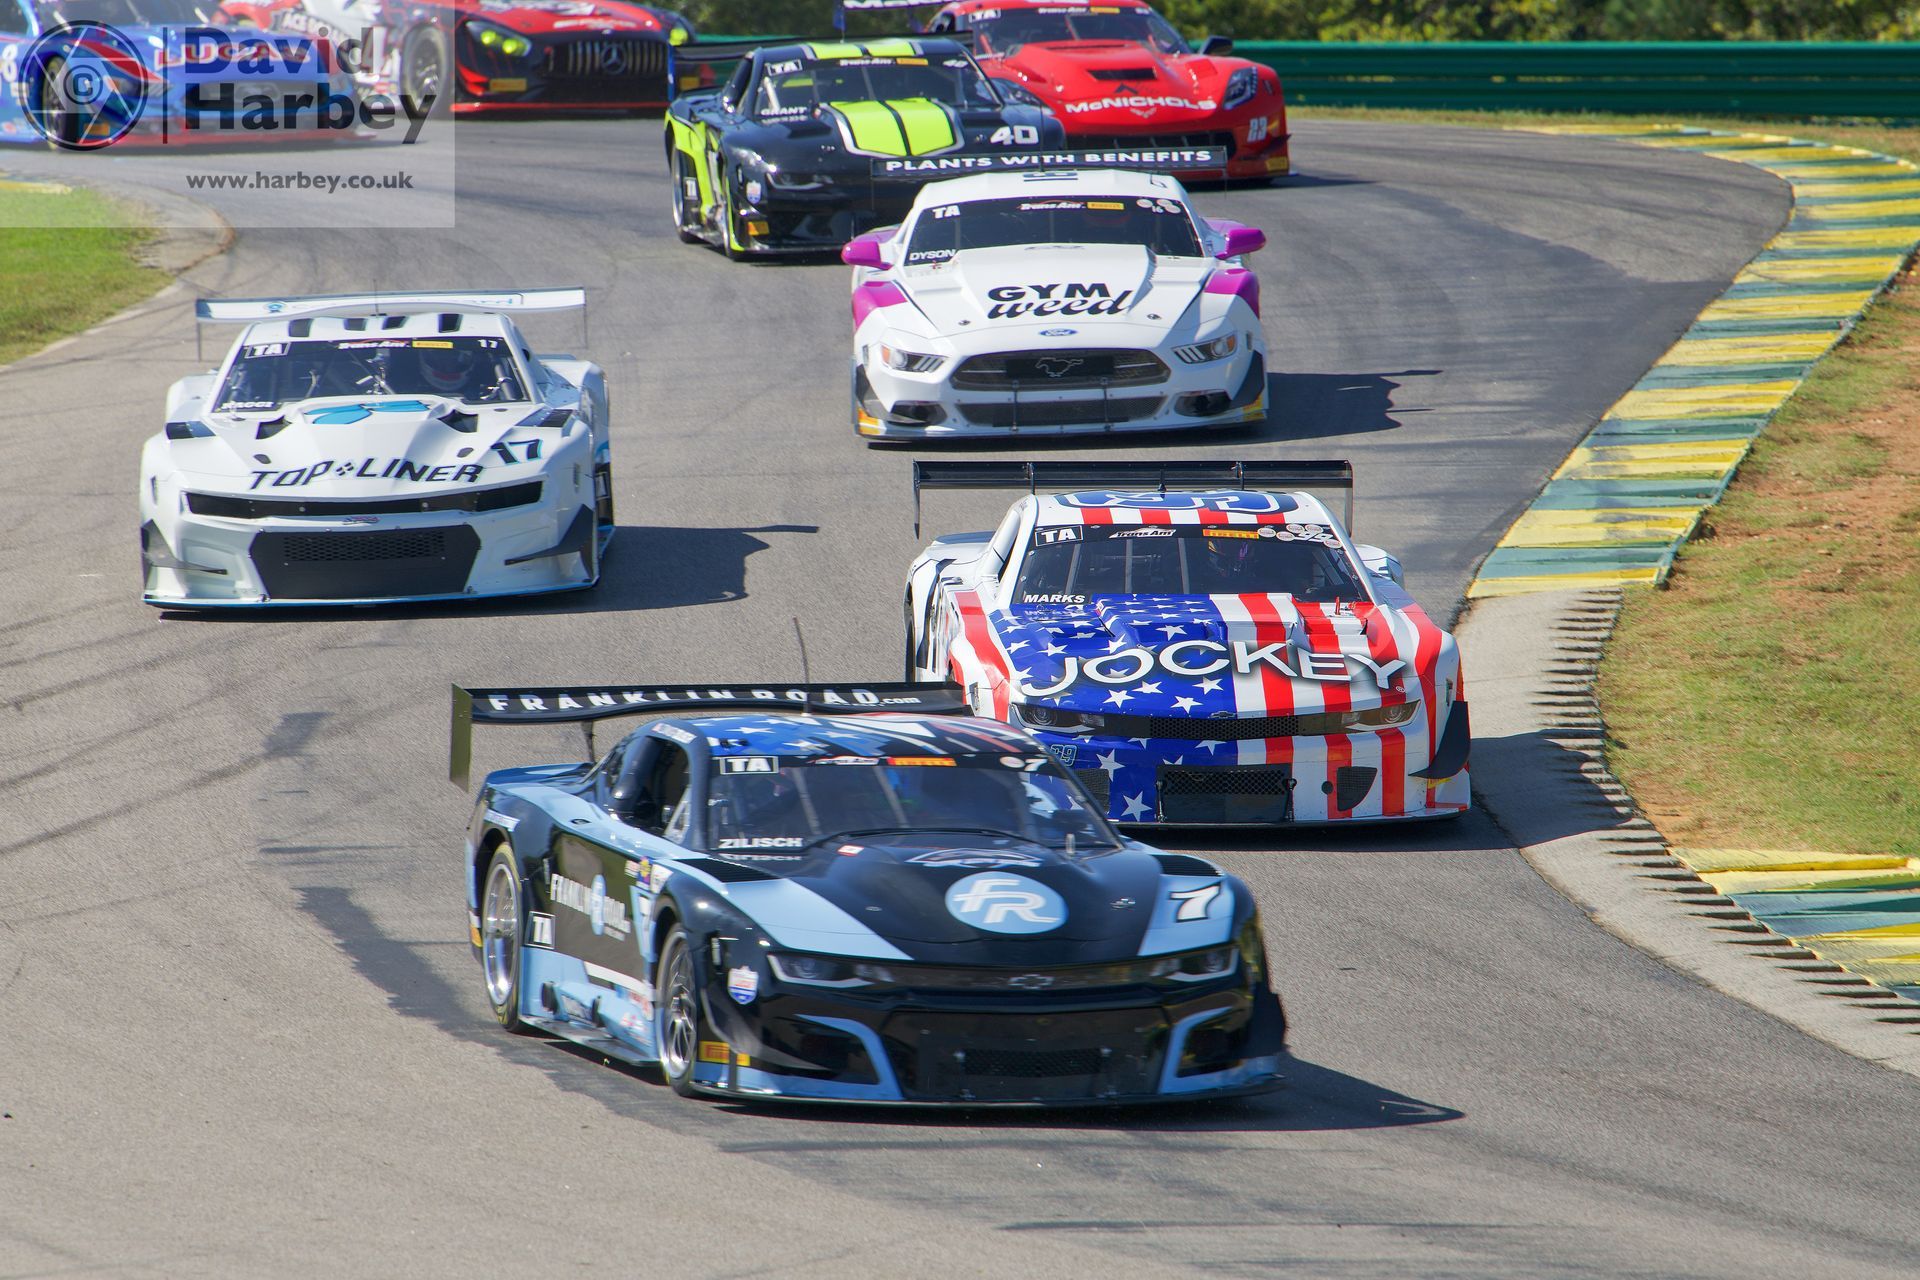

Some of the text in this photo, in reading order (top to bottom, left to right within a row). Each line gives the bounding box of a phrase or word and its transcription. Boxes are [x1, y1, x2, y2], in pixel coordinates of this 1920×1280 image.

[975, 9, 997, 21] TA
[155, 43, 310, 69] LUCAS
[774, 62, 798, 74] TA
[760, 106, 808, 117] GRANT
[1065, 95, 1217, 114] McNICHOLS
[990, 125, 1039, 145] 40
[886, 150, 1212, 172] PLANTS WITH BENEFITS
[933, 205, 960, 219] TA
[909, 249, 956, 261] DYSON
[988, 283, 1112, 301] GYM
[988, 290, 1133, 319] weed
[254, 343, 283, 356] TA
[478, 339, 499, 349] 17
[490, 439, 543, 465] 17
[250, 458, 484, 490] TOP LINER
[1041, 528, 1077, 542] TA
[1024, 594, 1085, 604] MARKS
[1020, 640, 1407, 698] JOCKEY
[488, 689, 734, 711] FRANKLIN
[728, 758, 772, 772] TA
[1024, 758, 1048, 772] 7
[718, 838, 803, 849] ZILISCH
[1171, 883, 1221, 922] 7
[533, 916, 553, 945] TA
